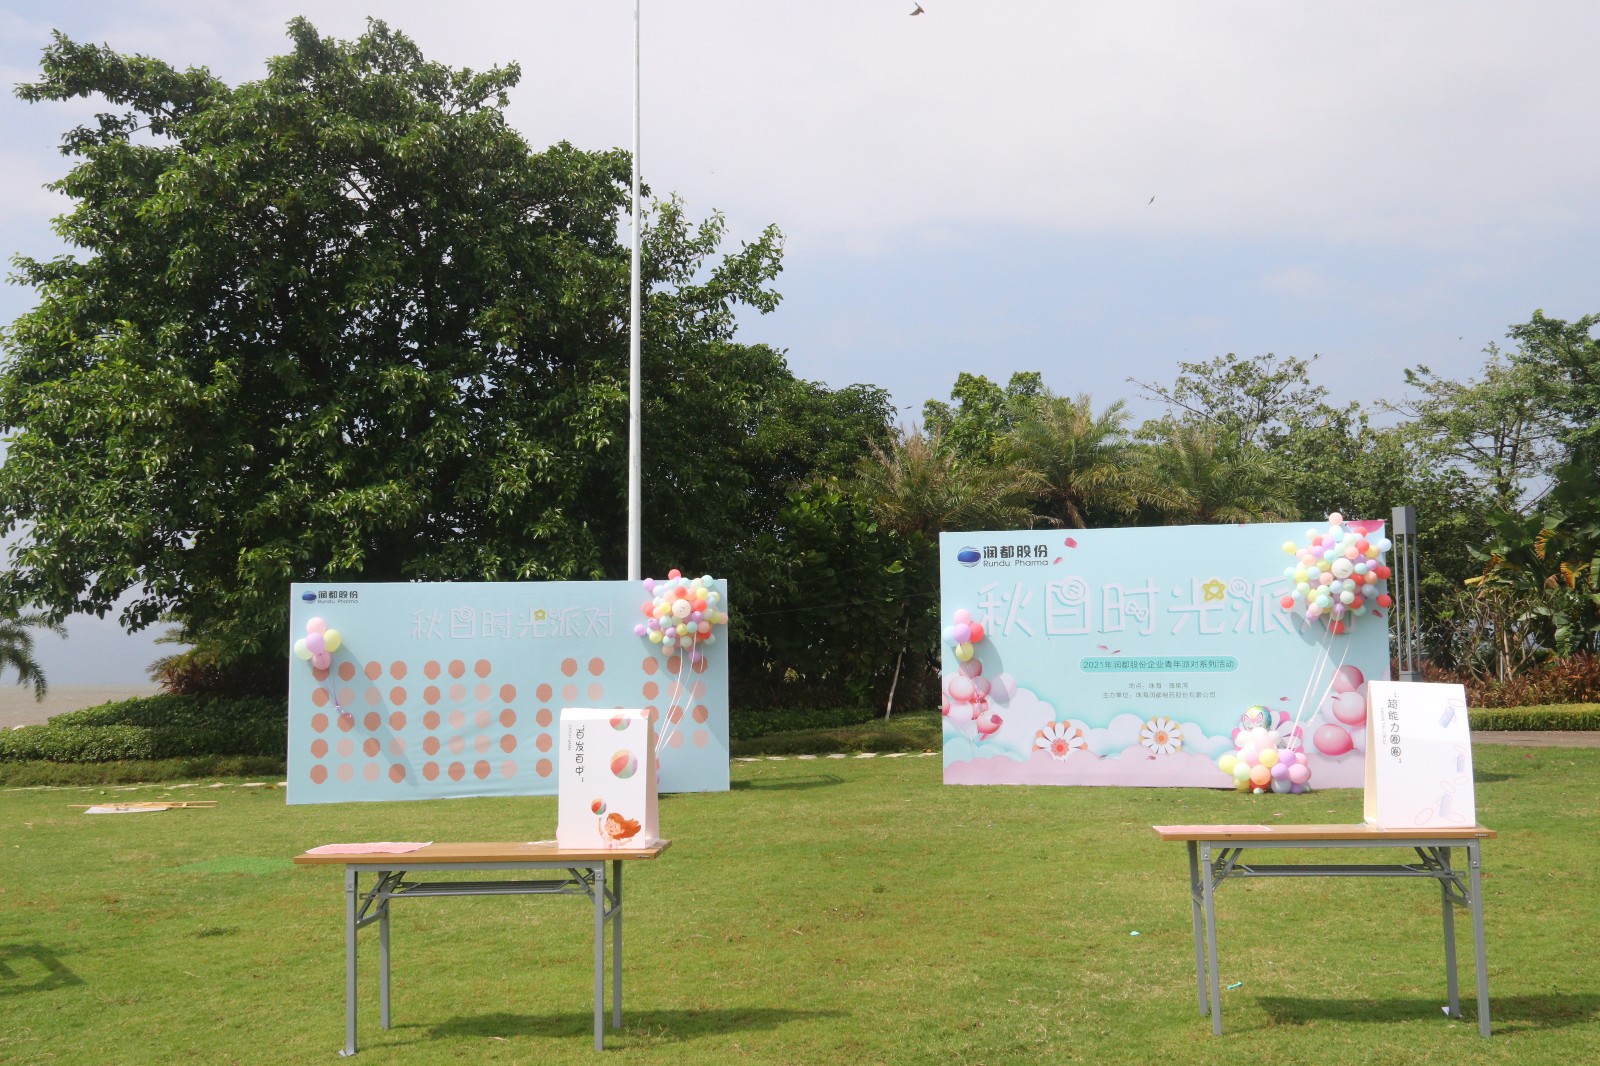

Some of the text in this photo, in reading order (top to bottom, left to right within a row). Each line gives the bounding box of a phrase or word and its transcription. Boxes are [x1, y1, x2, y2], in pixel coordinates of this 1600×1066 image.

[983, 544, 1048, 559] 润都股份
[318, 591, 358, 599] 润都股份
[977, 576, 1358, 637] 秋日时光派
[411, 606, 616, 639] 秋日时光派对
[1083, 659, 1235, 670] 2021年润都股份企业青年派对系列活动
